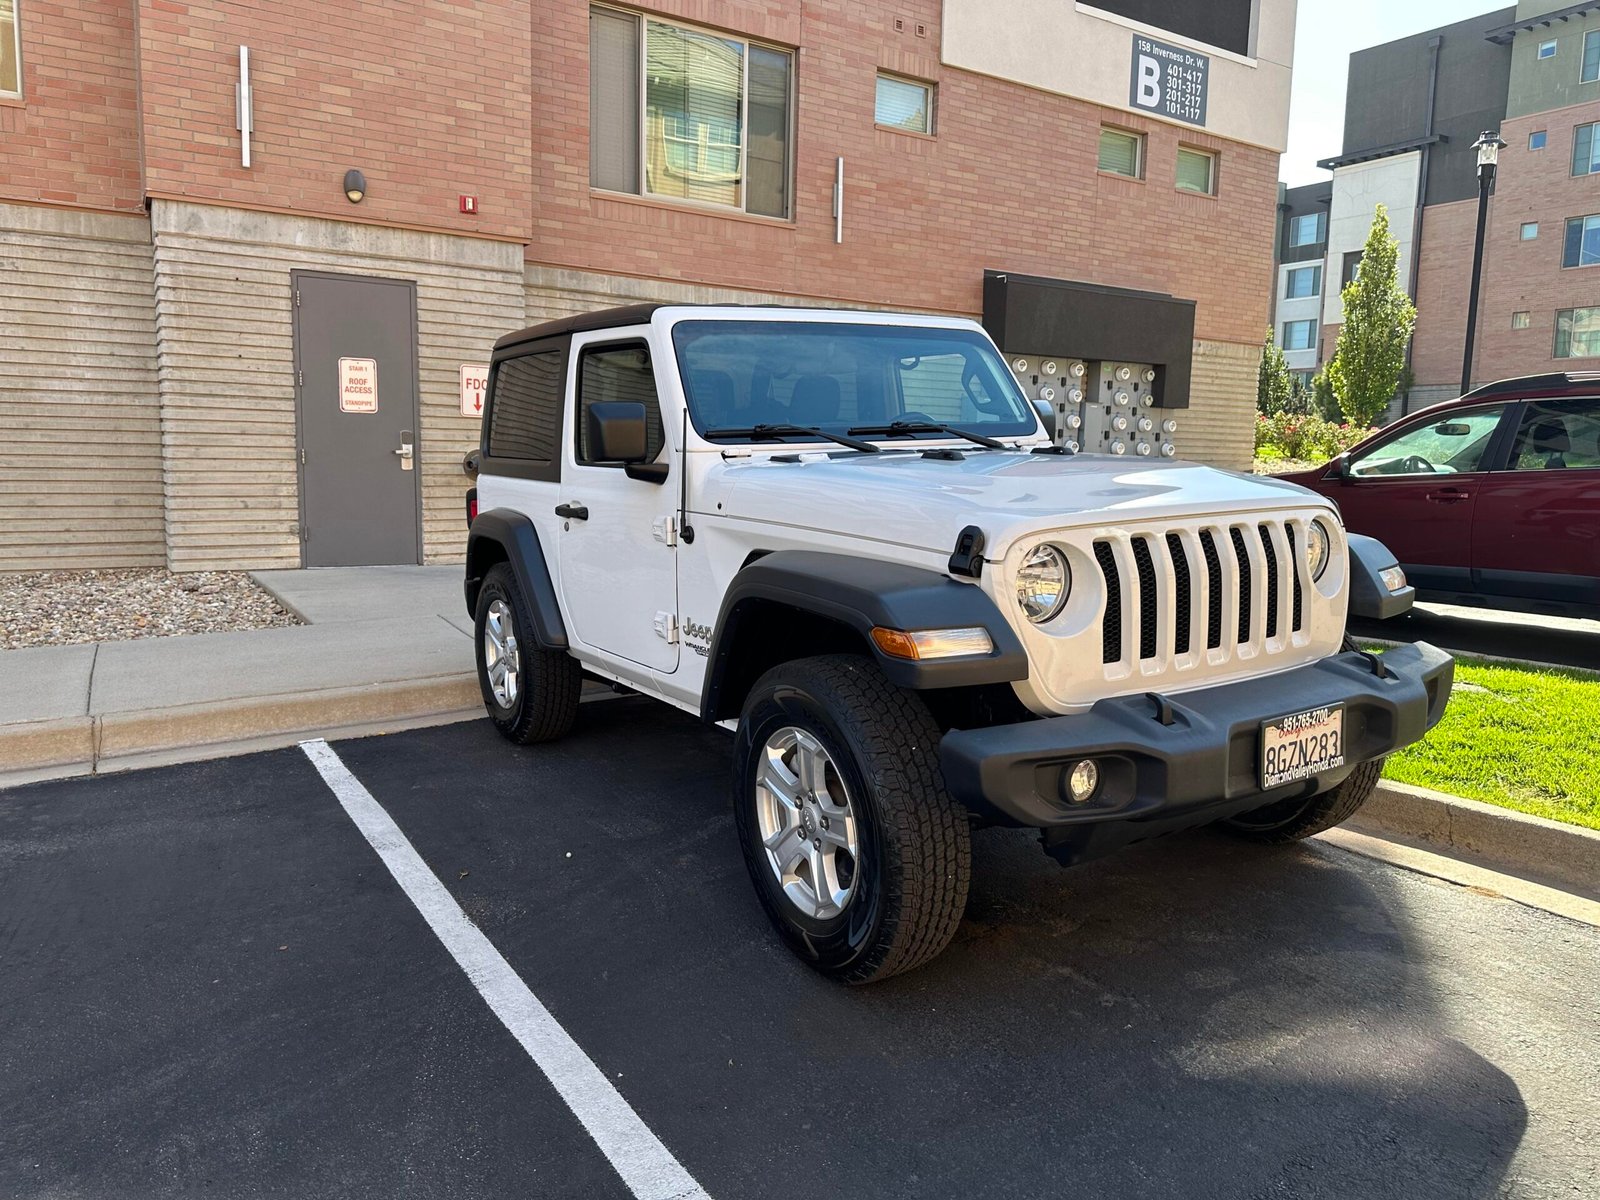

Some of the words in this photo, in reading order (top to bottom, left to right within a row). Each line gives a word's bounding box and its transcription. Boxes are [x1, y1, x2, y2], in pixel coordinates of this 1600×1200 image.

[1138, 40, 1151, 53] 158
[1152, 44, 1183, 63] Inverness
[1185, 55, 1195, 66] Dr.
[1196, 58, 1204, 69] W.
[1137, 54, 1160, 108] B
[1167, 63, 1202, 84] 401-417
[1166, 76, 1201, 96] 301-317
[1166, 88, 1201, 108] 201-217
[1166, 101, 1200, 120] 101-117
[344, 385, 373, 394] ACCESS
[348, 377, 368, 386] ROOF
[682, 616, 714, 645] Jeep
[1283, 708, 1329, 731] 951-765-2700
[1266, 730, 1338, 774] 8GZN283
[1264, 755, 1344, 788] DiamondValleyHonda.com
